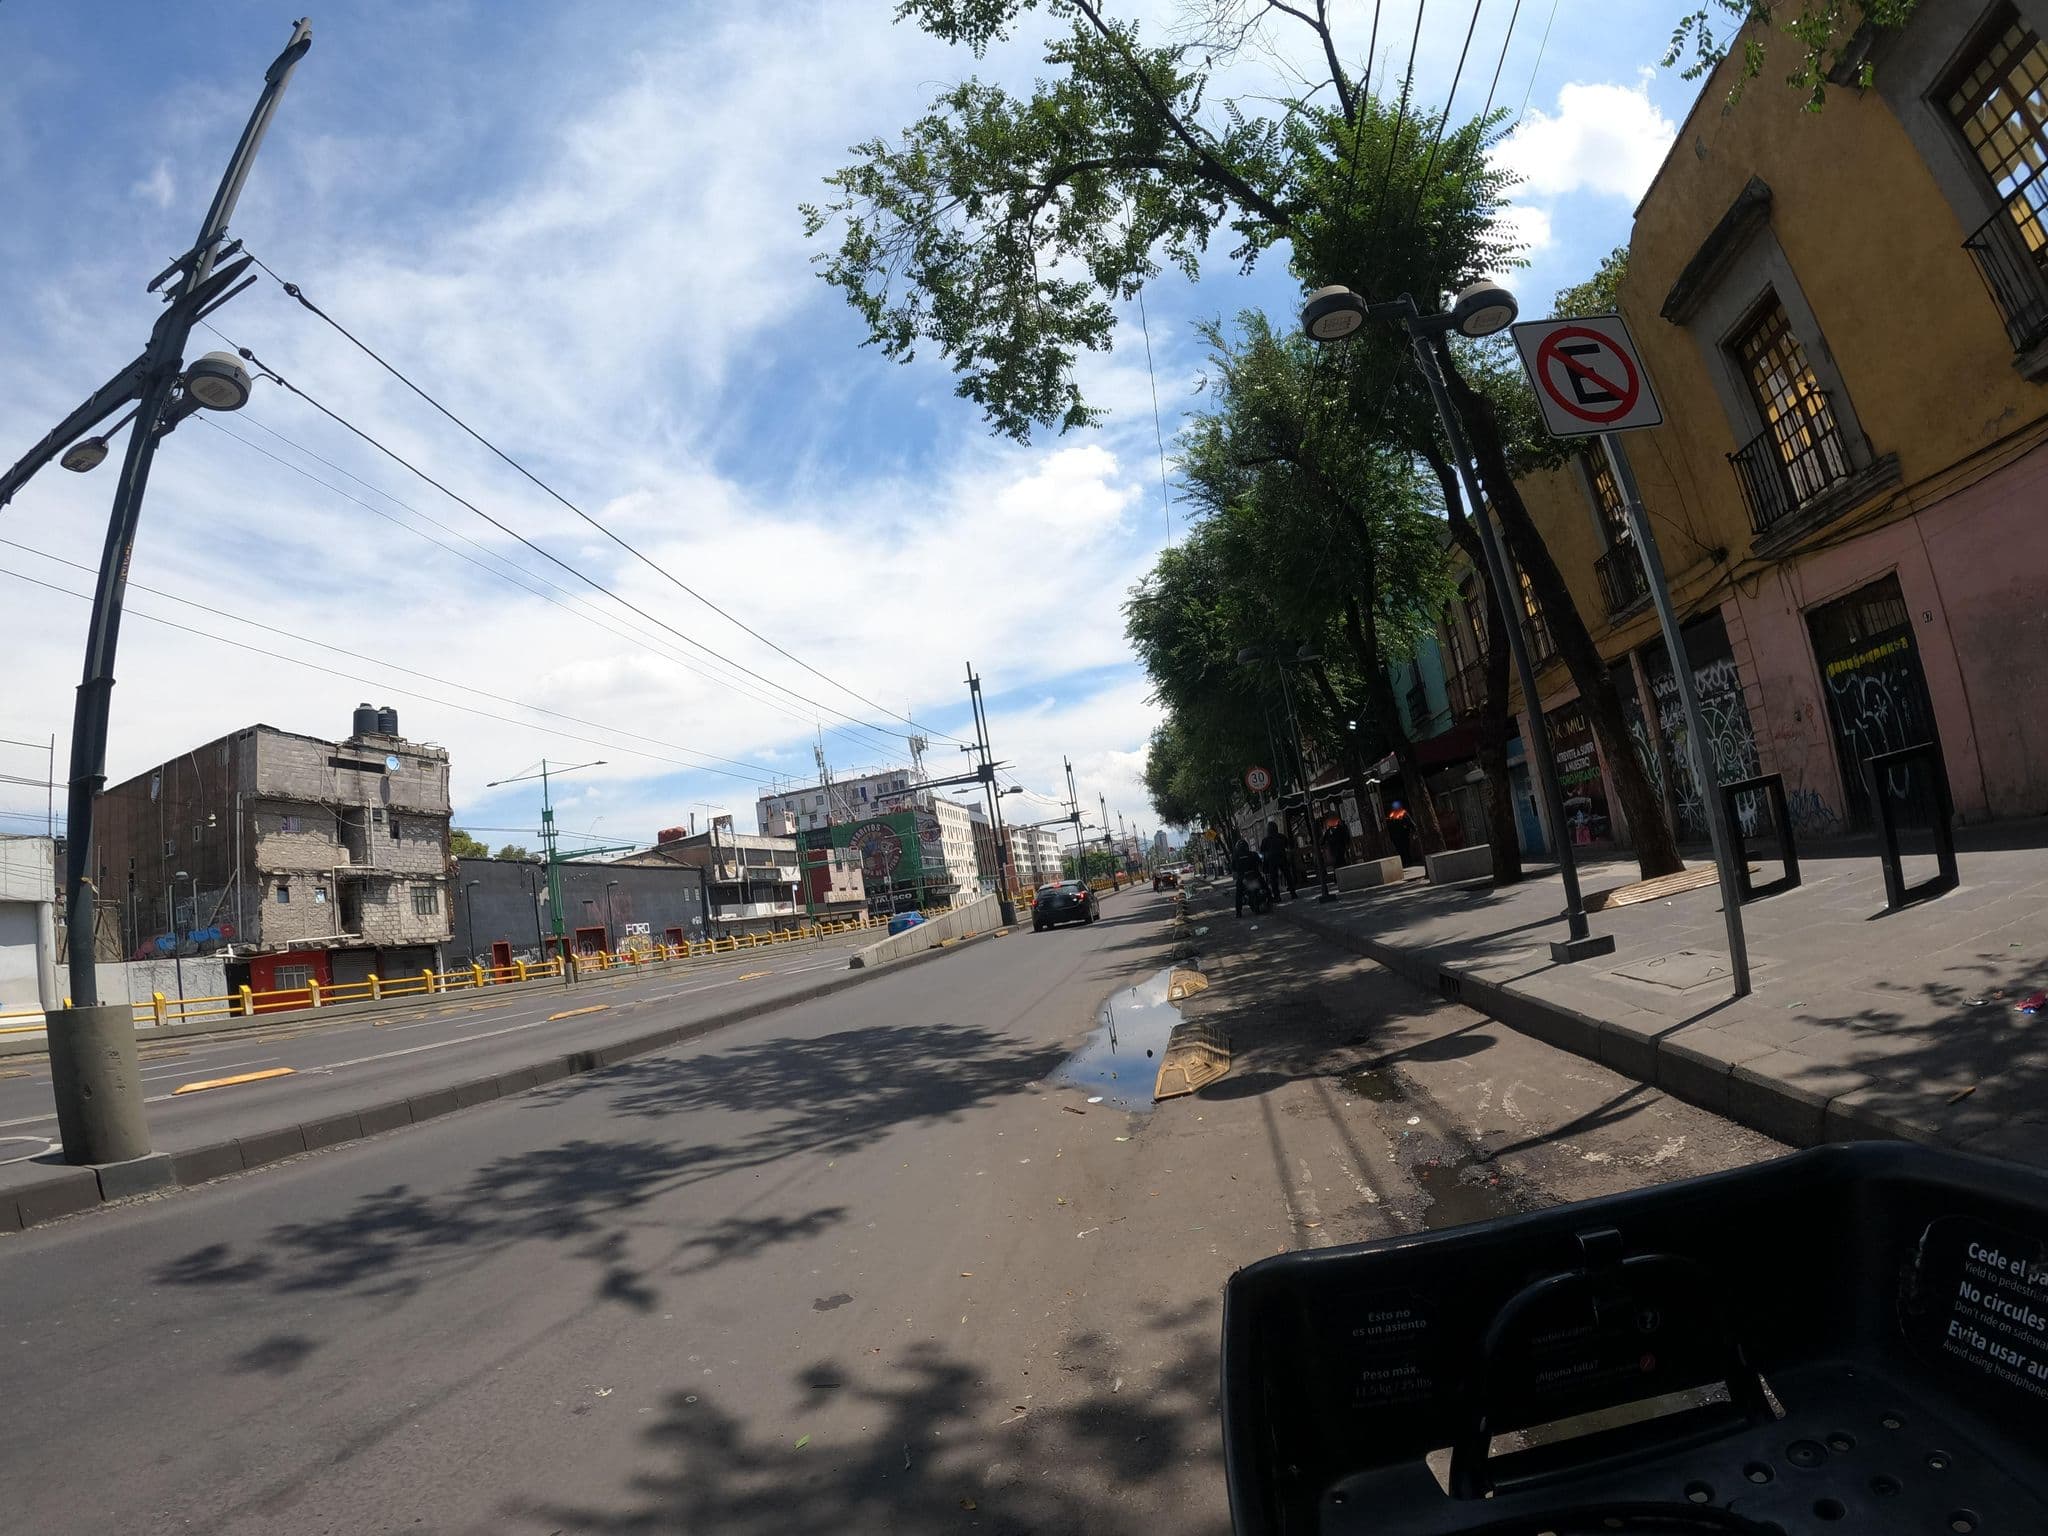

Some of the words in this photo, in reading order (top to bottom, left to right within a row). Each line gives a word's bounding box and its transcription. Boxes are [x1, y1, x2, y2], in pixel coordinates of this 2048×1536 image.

[1251, 772, 1264, 783] 30
[625, 922, 650, 935] FORO
[1965, 1259, 1987, 1279] Yield
[1987, 1272, 1998, 1283] to
[1968, 1242, 2007, 1270] Cede
[2010, 1259, 2027, 1278] el
[1367, 1310, 1393, 1322] Esto
[1395, 1309, 1411, 1319] no
[1954, 1301, 1979, 1320] Don't
[1980, 1313, 1999, 1328] ride
[1999, 1322, 2012, 1334] on
[1959, 1280, 1981, 1303] No
[1983, 1292, 2047, 1331] circules
[1352, 1328, 1365, 1337] es
[1367, 1326, 1382, 1335] un
[1384, 1319, 1427, 1333] asiento
[1947, 1320, 1987, 1351] Evita
[1989, 1342, 2027, 1368] usar
[1942, 1339, 1968, 1360] Avoid
[1968, 1354, 1993, 1374] using
[1362, 1369, 1390, 1381] Peso
